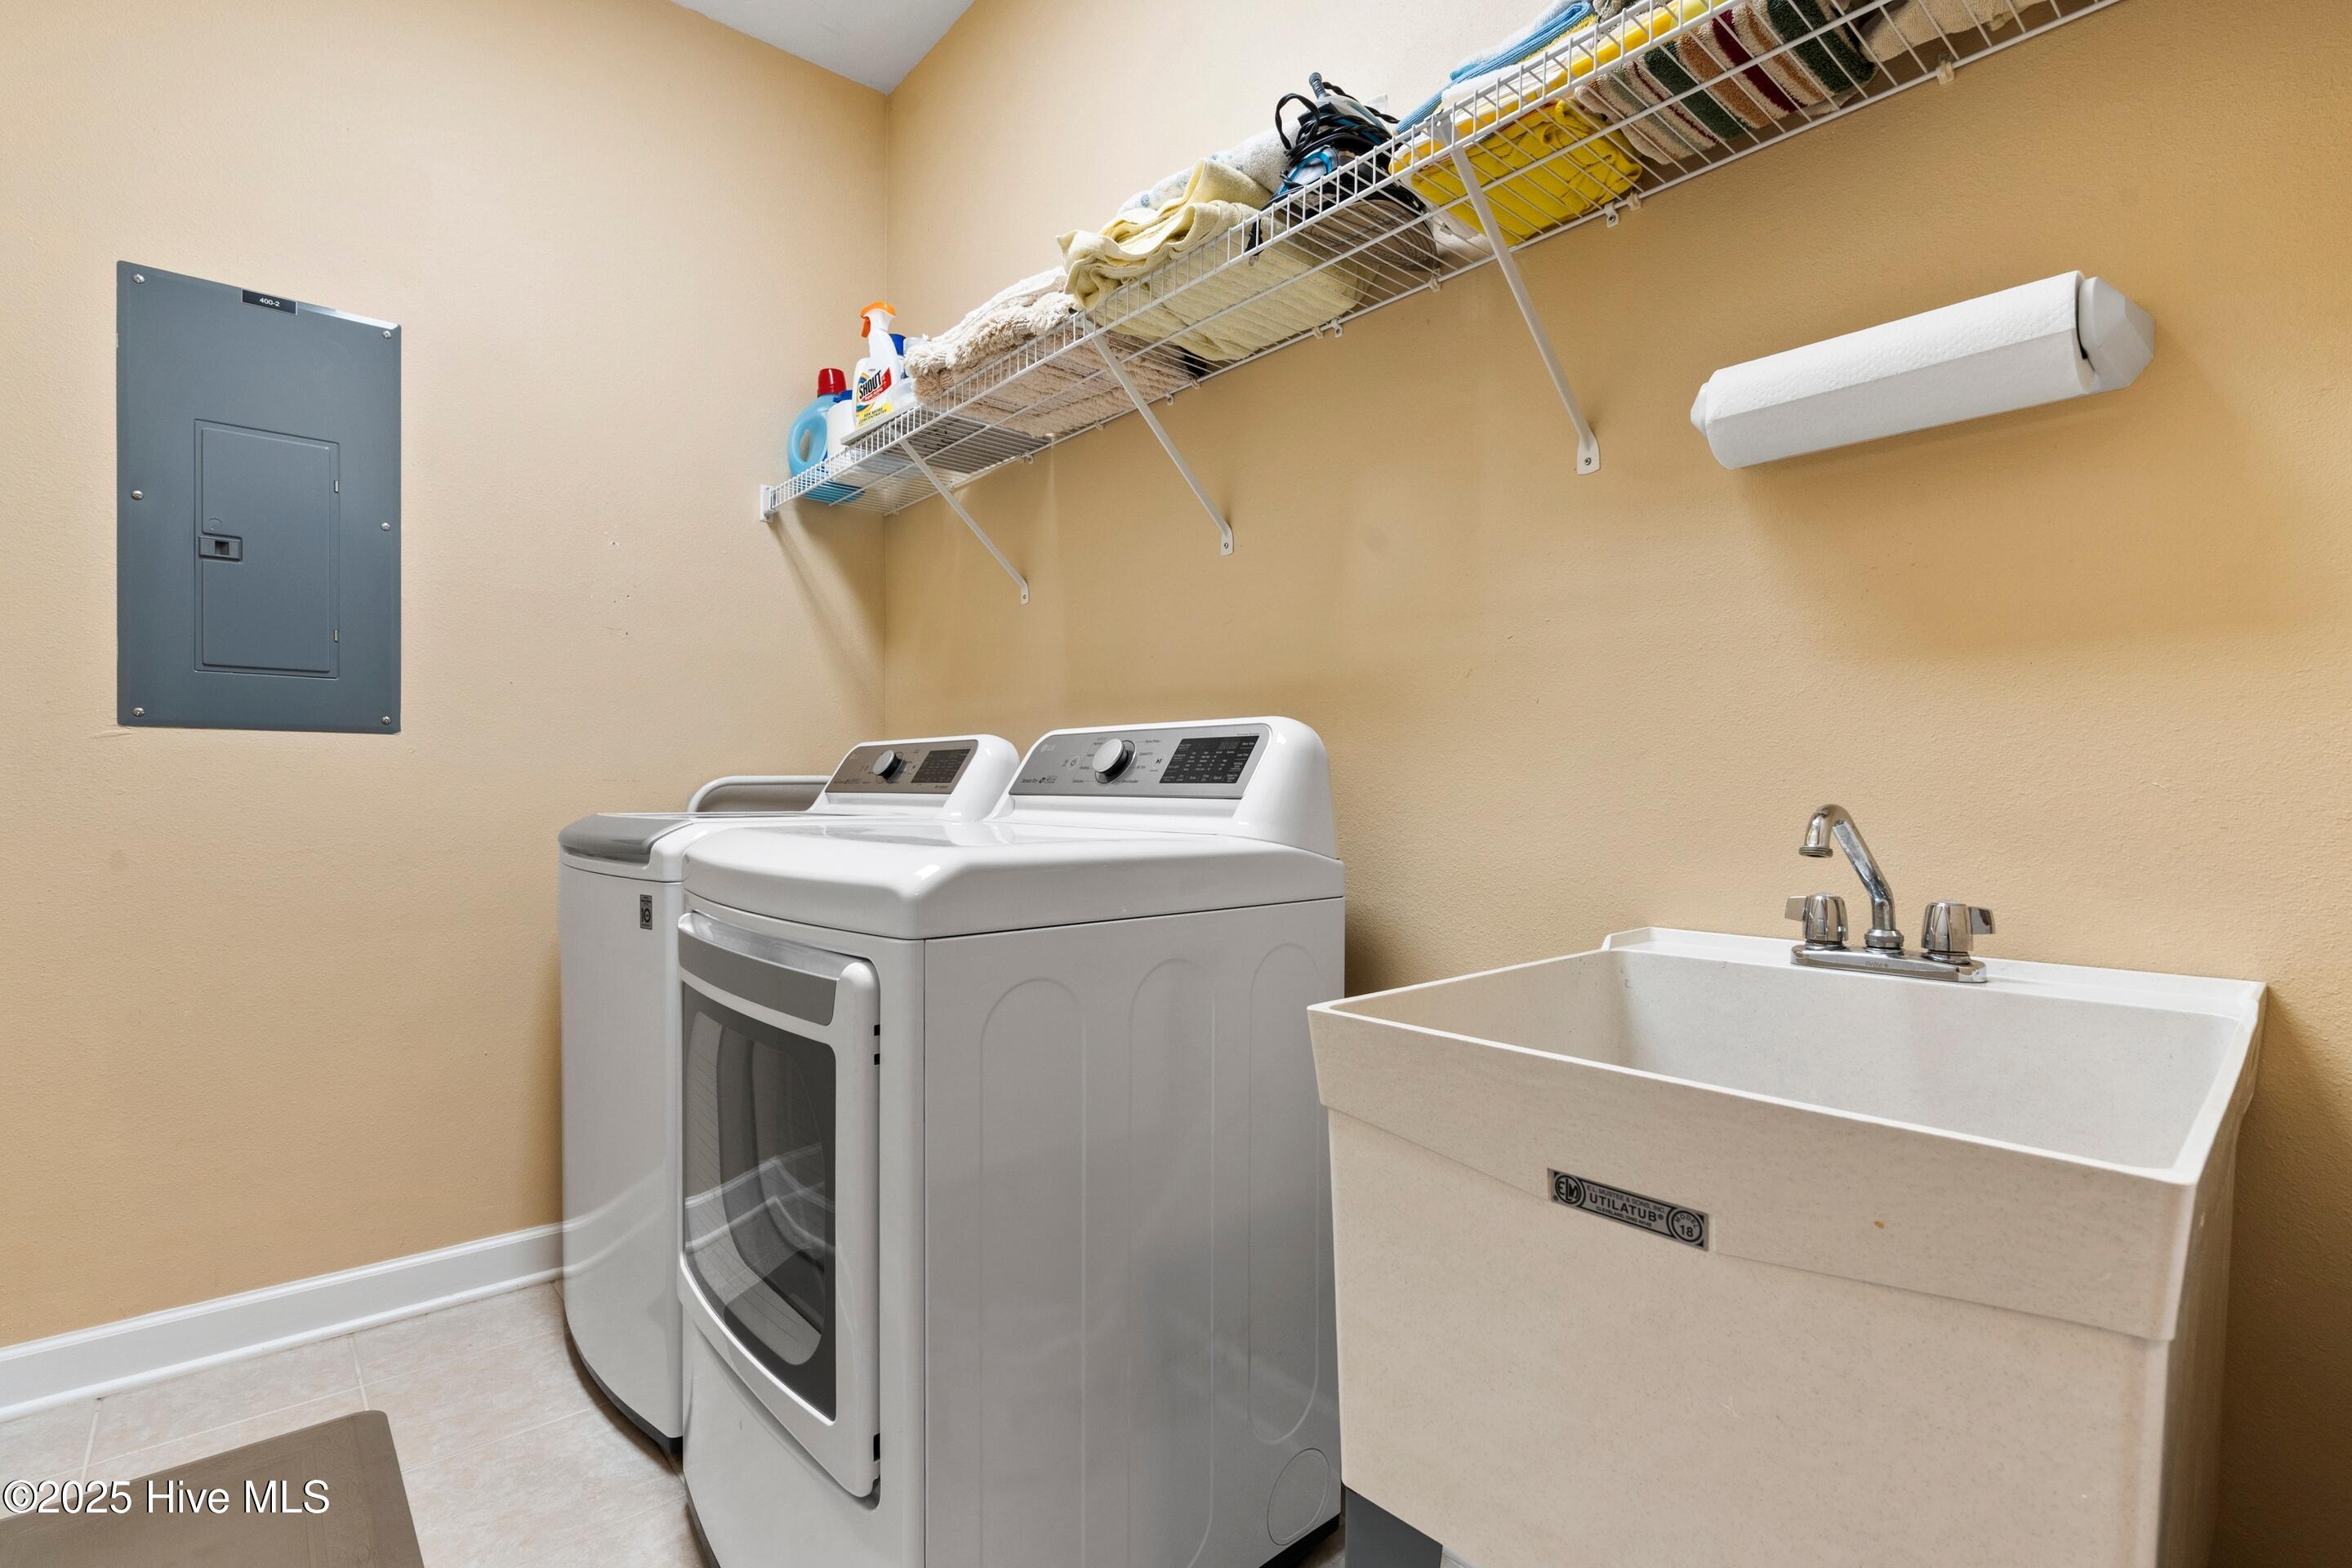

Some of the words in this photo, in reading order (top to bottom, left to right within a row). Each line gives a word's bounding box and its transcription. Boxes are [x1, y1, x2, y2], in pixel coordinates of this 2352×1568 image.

[260, 297, 280, 306] 400-2
[859, 370, 882, 399] SHOUT
[1598, 1188, 1625, 1201] MUSTEE
[1625, 1215, 1638, 1223] OHIO
[1675, 1214, 1699, 1229] MODEL
[1679, 1225, 1694, 1237] 18
